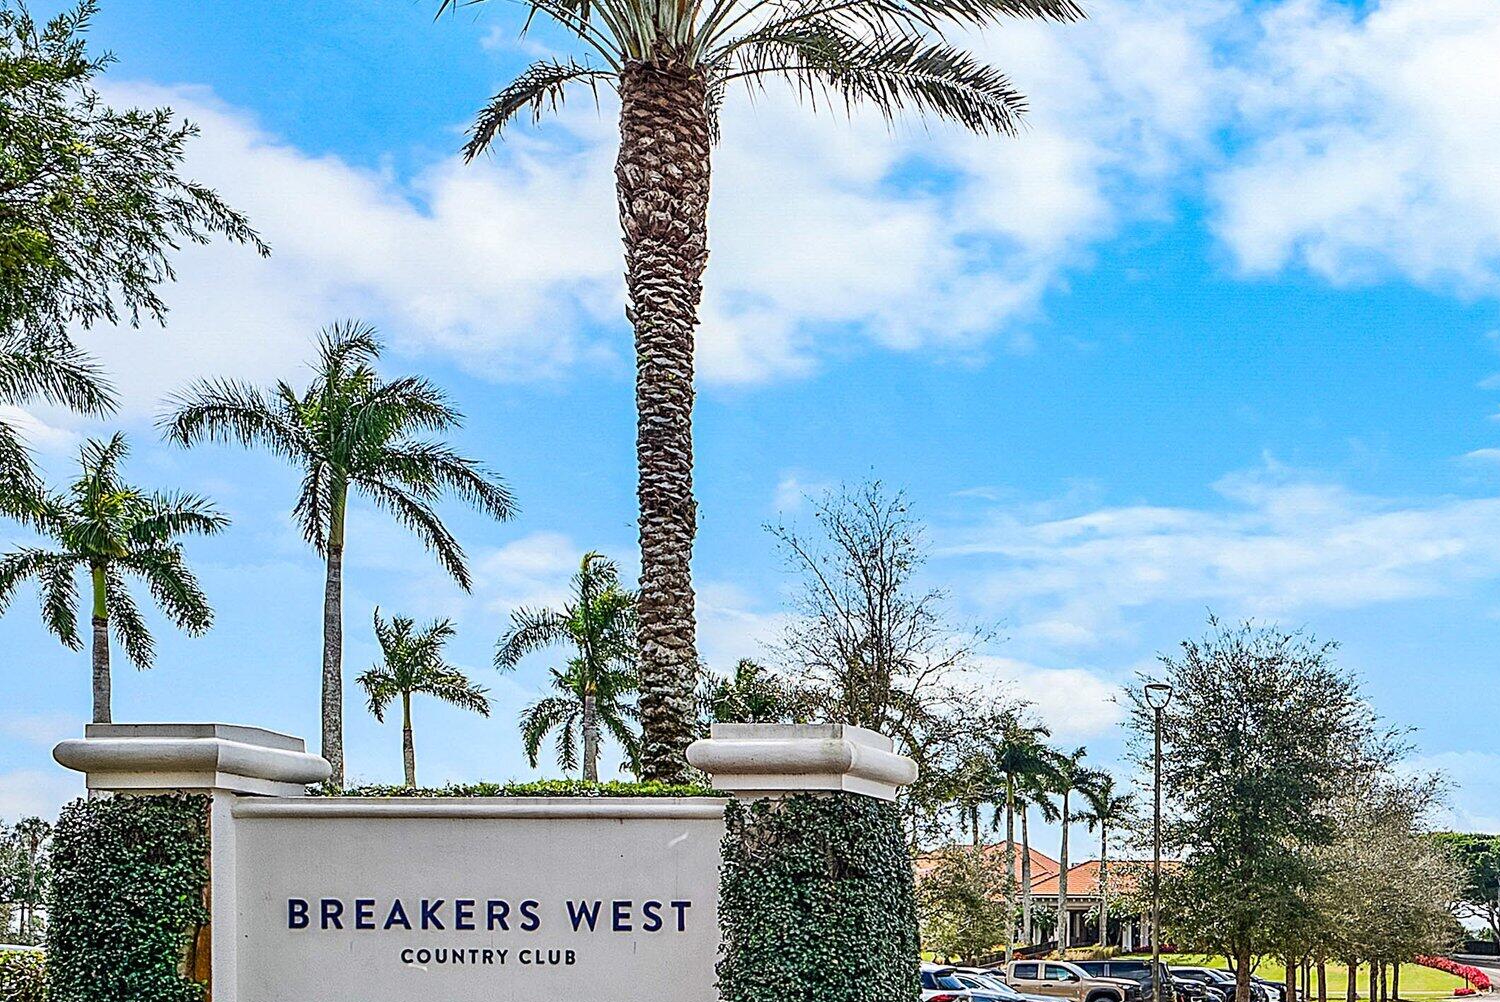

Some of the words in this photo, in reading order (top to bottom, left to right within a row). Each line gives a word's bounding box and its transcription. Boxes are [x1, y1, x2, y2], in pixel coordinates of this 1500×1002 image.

[288, 899, 541, 932] BREAKERS
[566, 900, 692, 933] WEST
[401, 948, 508, 965] COUNTRY
[519, 949, 577, 965] CLUB
